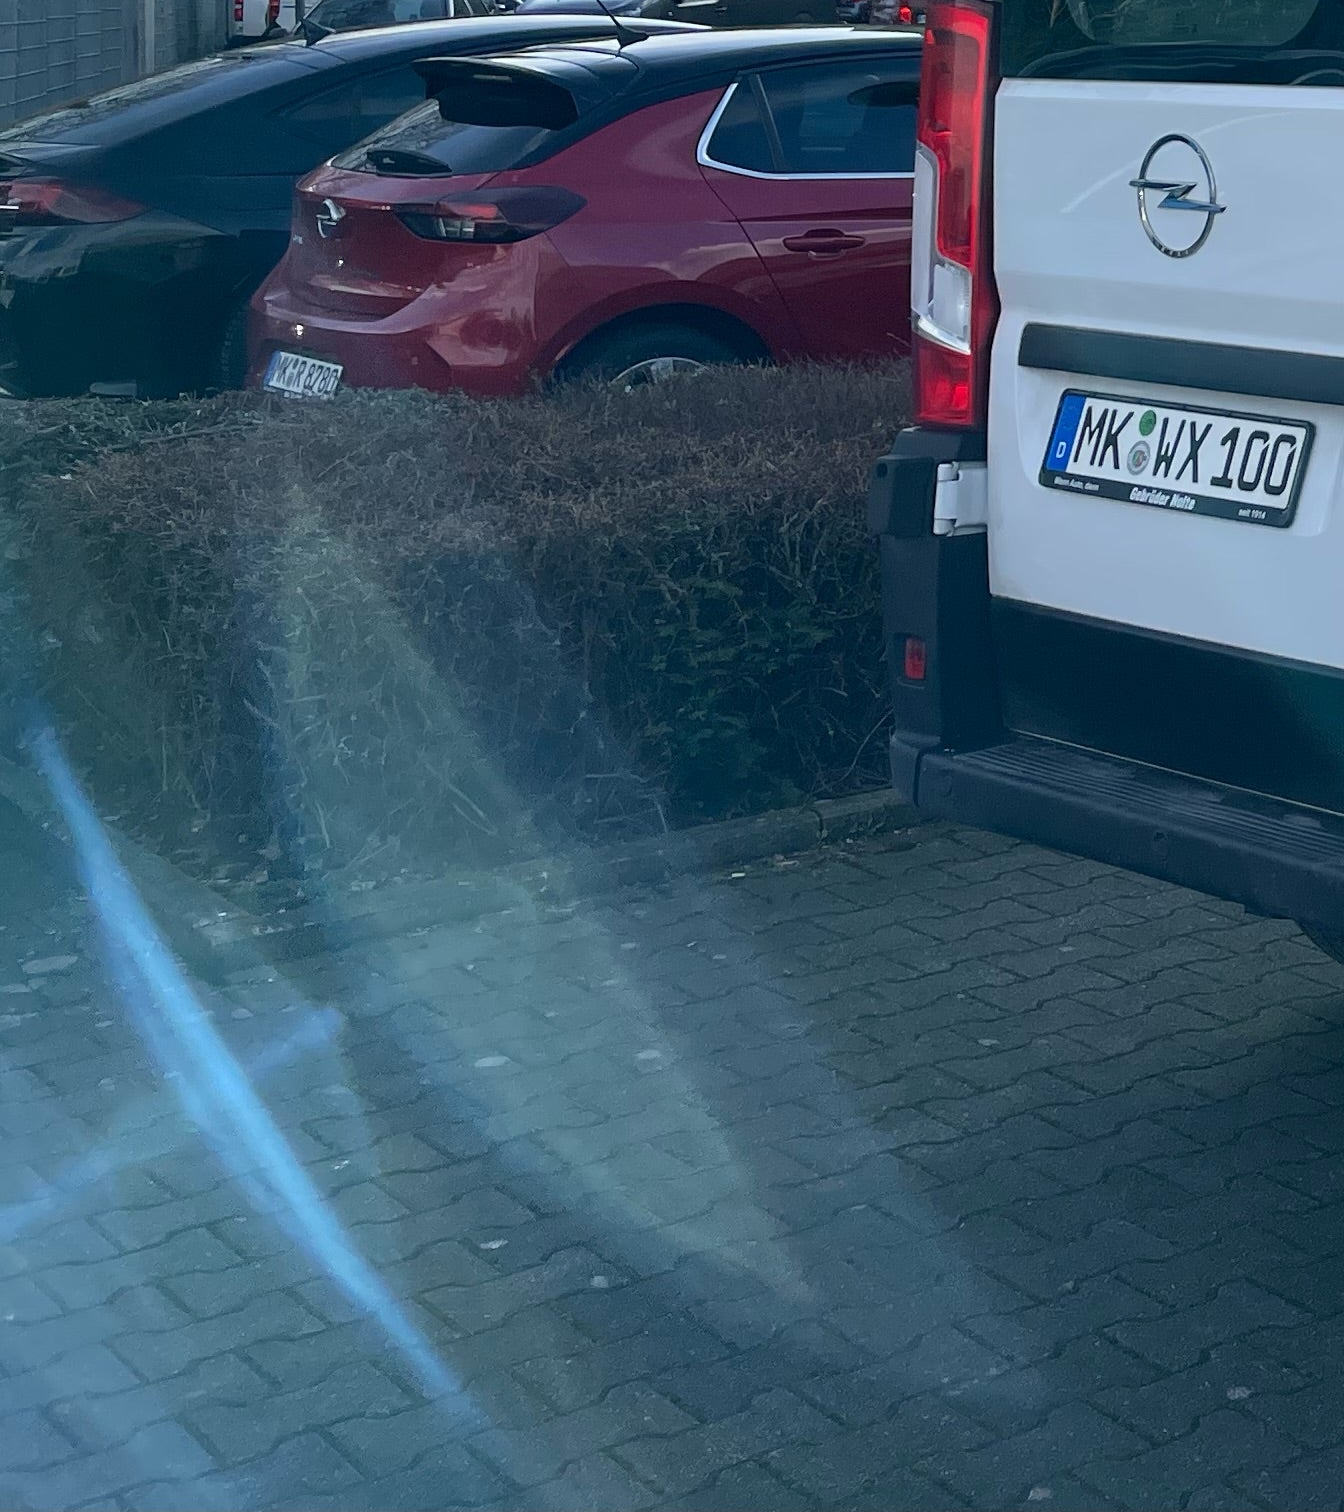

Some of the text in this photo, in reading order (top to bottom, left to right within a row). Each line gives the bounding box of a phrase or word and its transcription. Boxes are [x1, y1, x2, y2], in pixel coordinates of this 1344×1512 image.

[1073, 405, 1298, 495] MK WX 100
[1129, 486, 1196, 510] Gebrüder Nolte
